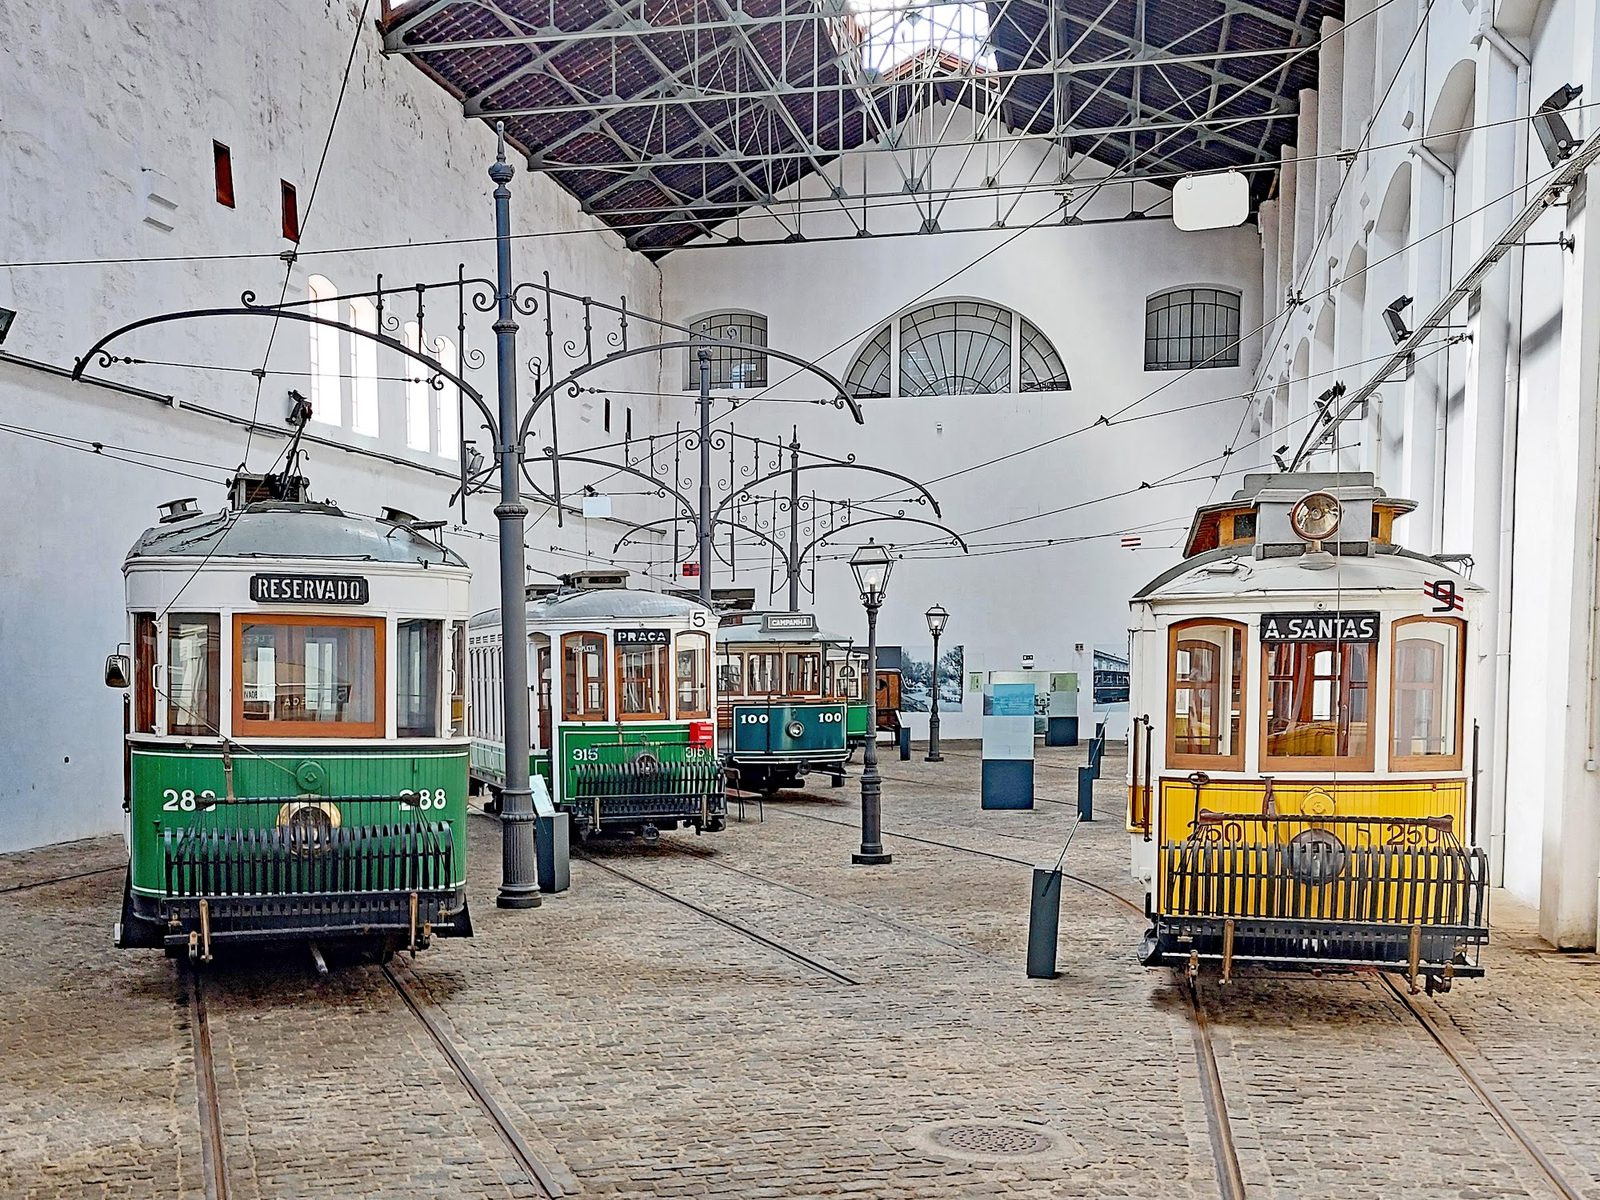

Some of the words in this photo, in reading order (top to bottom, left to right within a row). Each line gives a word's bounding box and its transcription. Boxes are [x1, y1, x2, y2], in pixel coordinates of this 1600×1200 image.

[257, 579, 361, 600] RESERVADO
[1432, 580, 1455, 612] 9
[692, 612, 705, 627] 5
[617, 632, 666, 645] PRAÇA
[740, 714, 769, 725] 100
[818, 712, 842, 723] 100
[573, 748, 599, 761] 315
